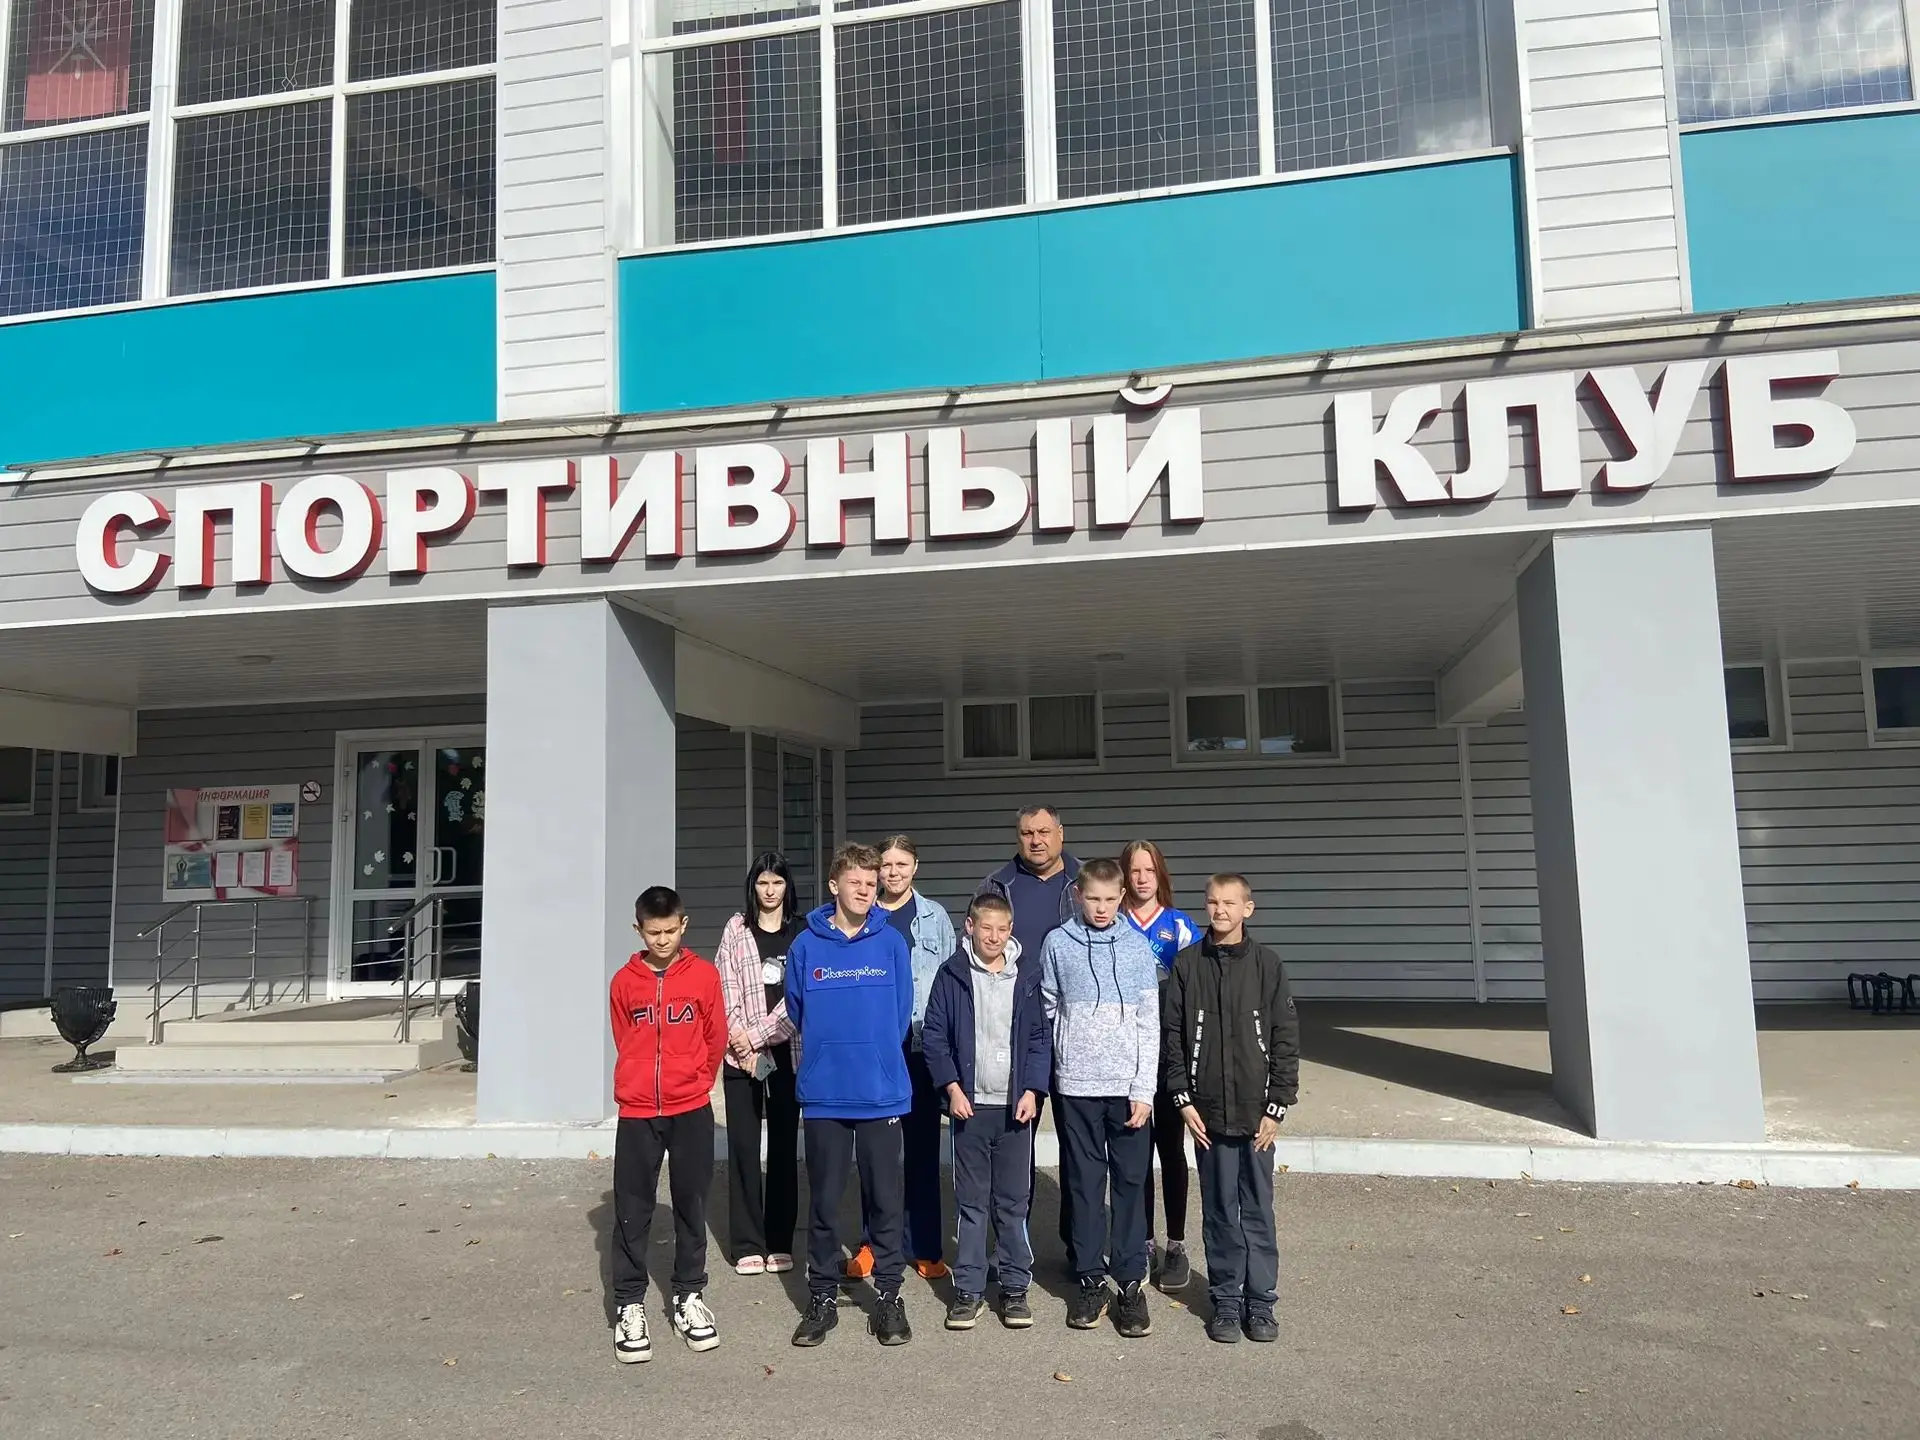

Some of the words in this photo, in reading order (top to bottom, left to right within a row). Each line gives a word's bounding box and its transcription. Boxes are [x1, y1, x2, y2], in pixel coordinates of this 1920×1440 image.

[75, 384, 1205, 595] СПОРТИВНЫЙ
[1332, 350, 1857, 511] КЛУБ
[197, 789, 270, 801] ИНФОРМАЦИЯ
[812, 965, 887, 981] Champion
[633, 1003, 694, 1027] FILA
